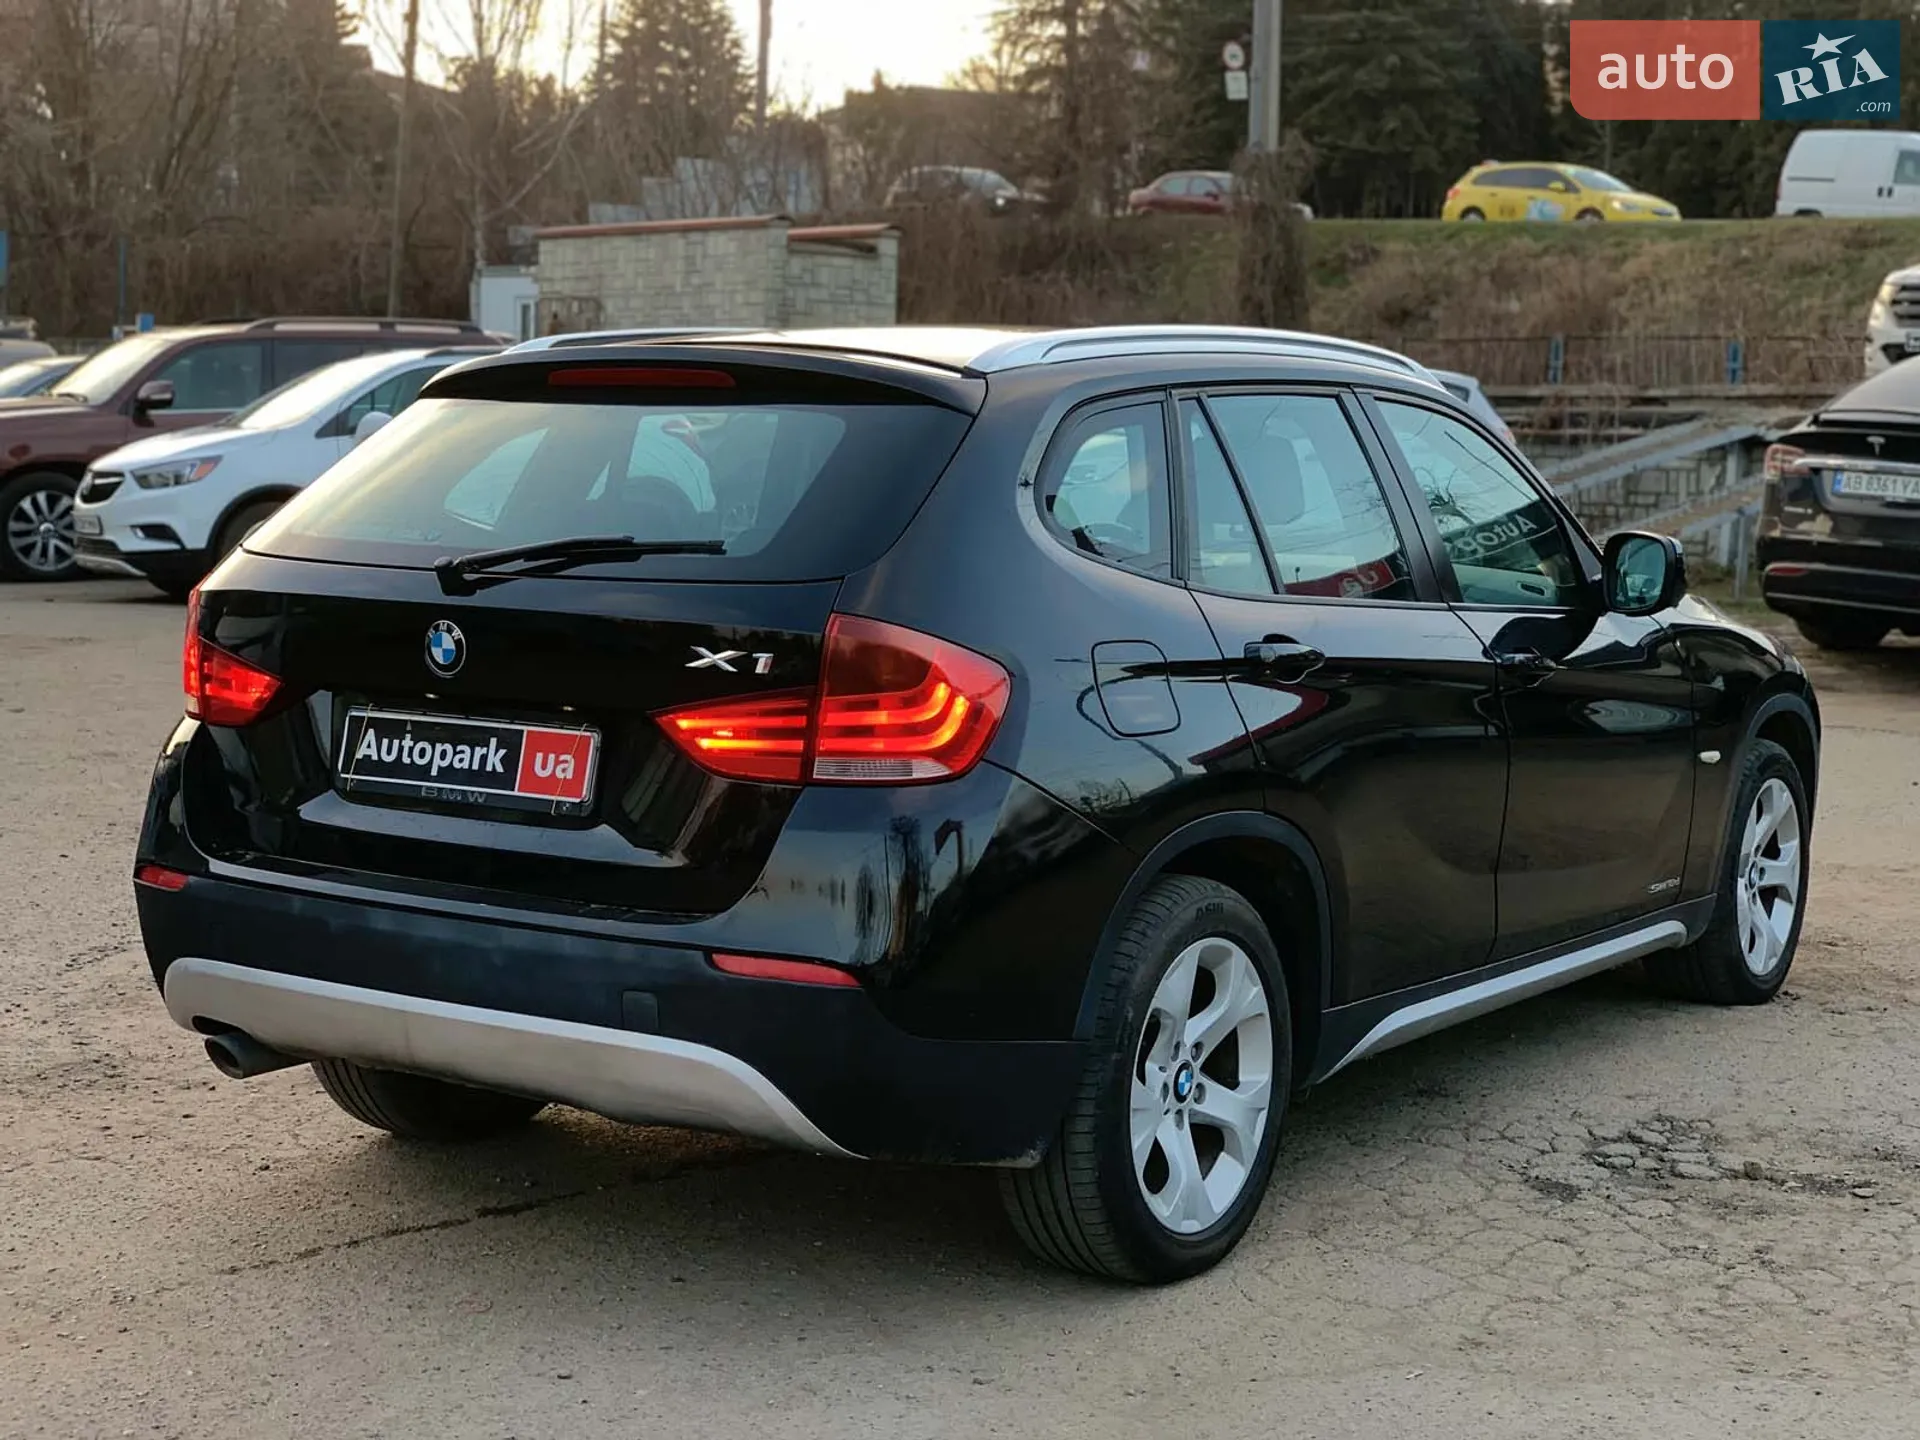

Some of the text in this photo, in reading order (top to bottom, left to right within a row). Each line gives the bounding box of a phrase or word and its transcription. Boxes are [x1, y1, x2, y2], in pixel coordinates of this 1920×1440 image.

[428, 622, 461, 640] BMW
[684, 645, 774, 674] X1
[355, 729, 575, 780] Autopark ua
[421, 785, 487, 803] BMW
